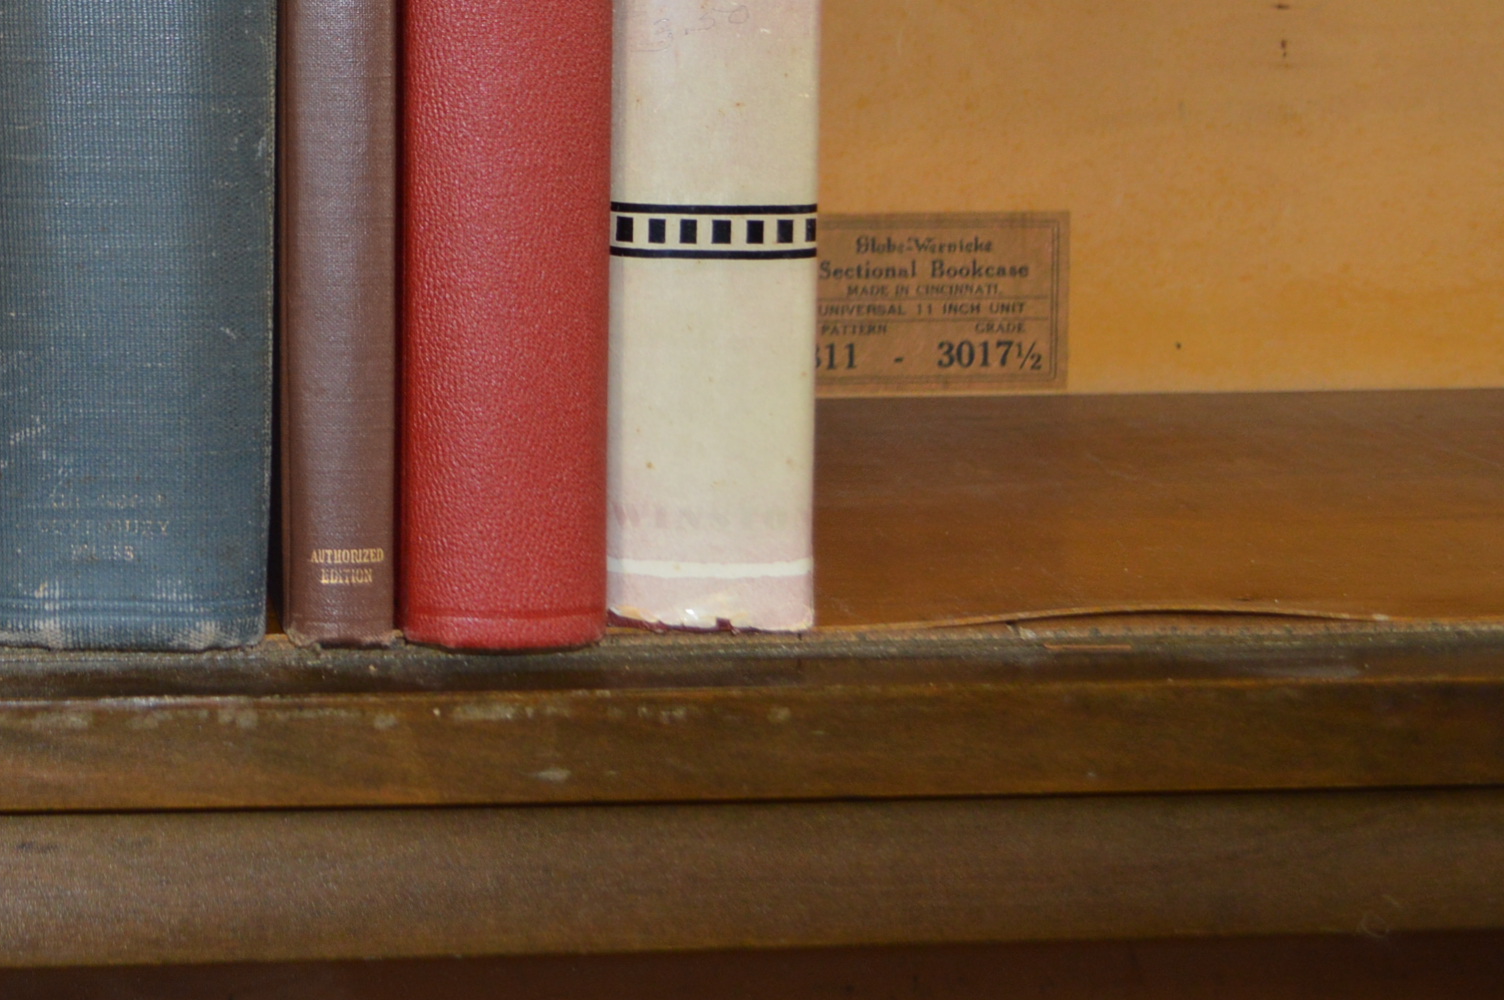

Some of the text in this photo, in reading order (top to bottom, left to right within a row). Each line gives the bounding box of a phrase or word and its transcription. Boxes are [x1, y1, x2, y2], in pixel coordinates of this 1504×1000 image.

[819, 258, 1029, 280] Sectional Bookcase
[847, 285, 889, 296] MADE
[895, 285, 910, 295] IN
[818, 301, 1025, 316] UNIVERSAL 11 INCH UNIT
[821, 322, 1026, 337] PATTERN GRADE
[310, 547, 384, 563] AUTHORIZED
